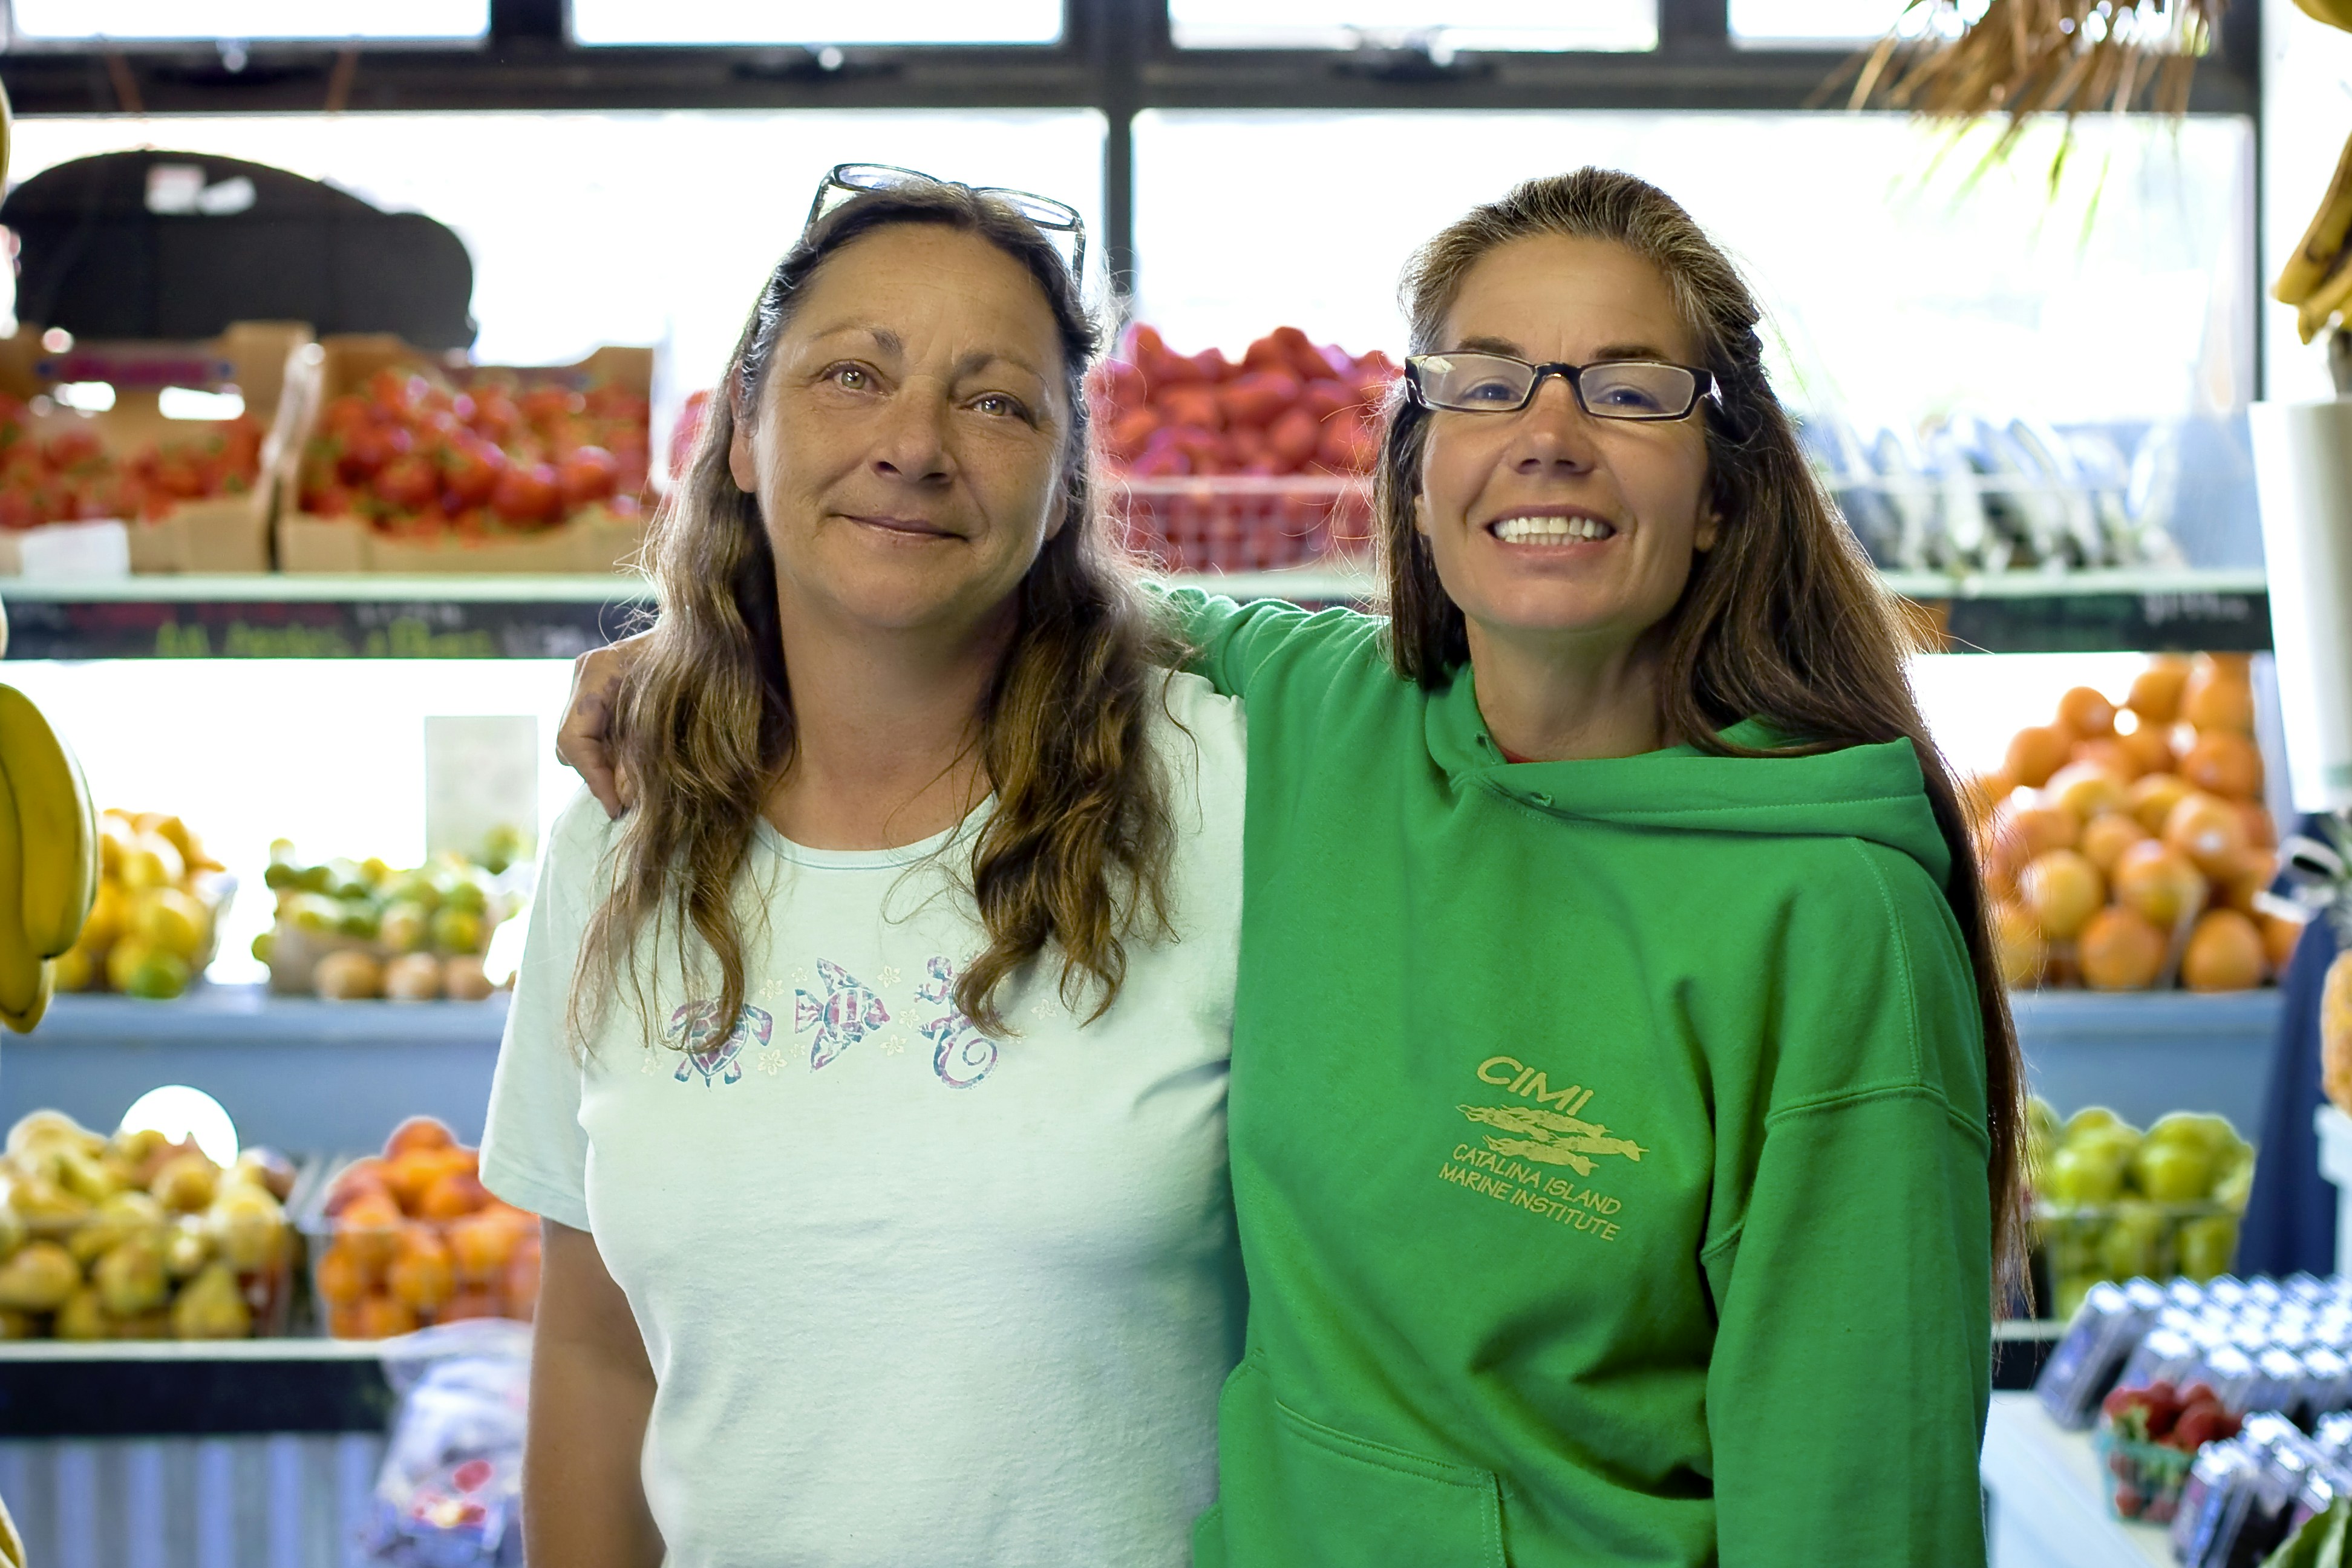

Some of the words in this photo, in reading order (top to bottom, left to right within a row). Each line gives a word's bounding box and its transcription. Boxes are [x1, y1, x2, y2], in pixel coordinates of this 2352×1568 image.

[1477, 1056, 1594, 1116] CIMI
[1439, 1162, 1513, 1200] MARINE
[1509, 1189, 1621, 1241] INSTITUTE
[1452, 1143, 1541, 1188] CATALINA
[1543, 1177, 1621, 1215] ISLAND
